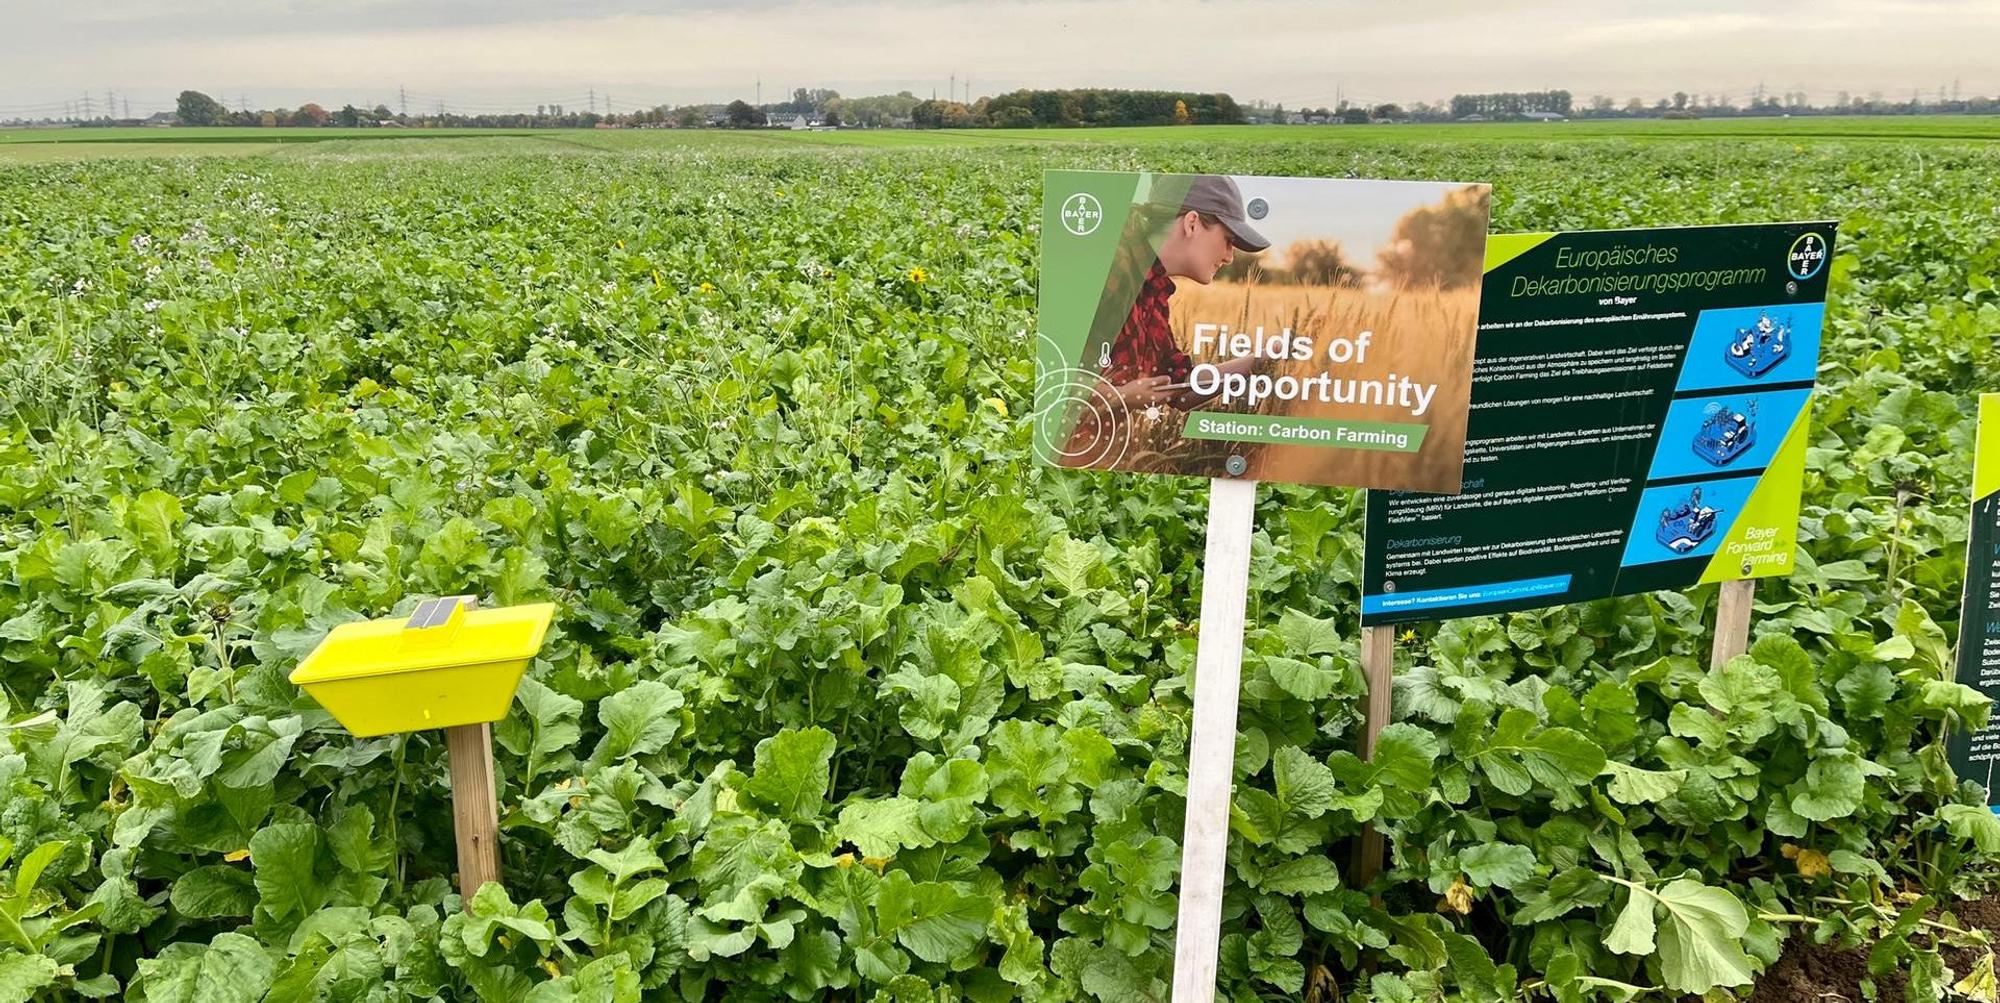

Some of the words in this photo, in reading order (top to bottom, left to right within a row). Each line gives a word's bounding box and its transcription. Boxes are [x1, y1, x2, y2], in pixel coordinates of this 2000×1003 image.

[1065, 210, 1099, 218] BAYER
[1556, 243, 1678, 270] Europäisches
[1791, 249, 1823, 261] BAYER
[1511, 267, 1767, 297] Dekarbonisierungsprogramm
[1614, 296, 1637, 306] Bayer
[1534, 317, 1583, 327] Dekarbonisierung
[1193, 323, 1314, 361] Fields
[1328, 331, 1372, 364] of
[1515, 371, 1538, 380] Farming
[1189, 363, 1438, 416] Opportunity
[1503, 398, 1530, 408] Lösungen
[1199, 419, 1263, 437] Station:
[1269, 423, 1331, 441] Carbon
[1336, 427, 1408, 448] Farming
[1505, 433, 1527, 441] arbeiten
[1536, 439, 1570, 449] Regierungen
[1745, 526, 1778, 540] Bayer
[1386, 534, 1461, 550] Dekarbonisierung
[1386, 550, 1420, 560] Gemeinsam
[1431, 546, 1462, 555] Landwirten
[1463, 544, 1481, 553] tragen
[1500, 537, 1545, 549] Dekarbonisierung
[1726, 539, 1774, 554] Forward
[1385, 559, 1410, 569] systems
[1423, 556, 1441, 564] Dabei
[1442, 554, 1464, 562] werden
[1464, 551, 1487, 561] positive
[1741, 552, 1787, 567] Farming
[1382, 597, 1414, 606] Interesse?
[1416, 593, 1456, 603] Kontaktieren
